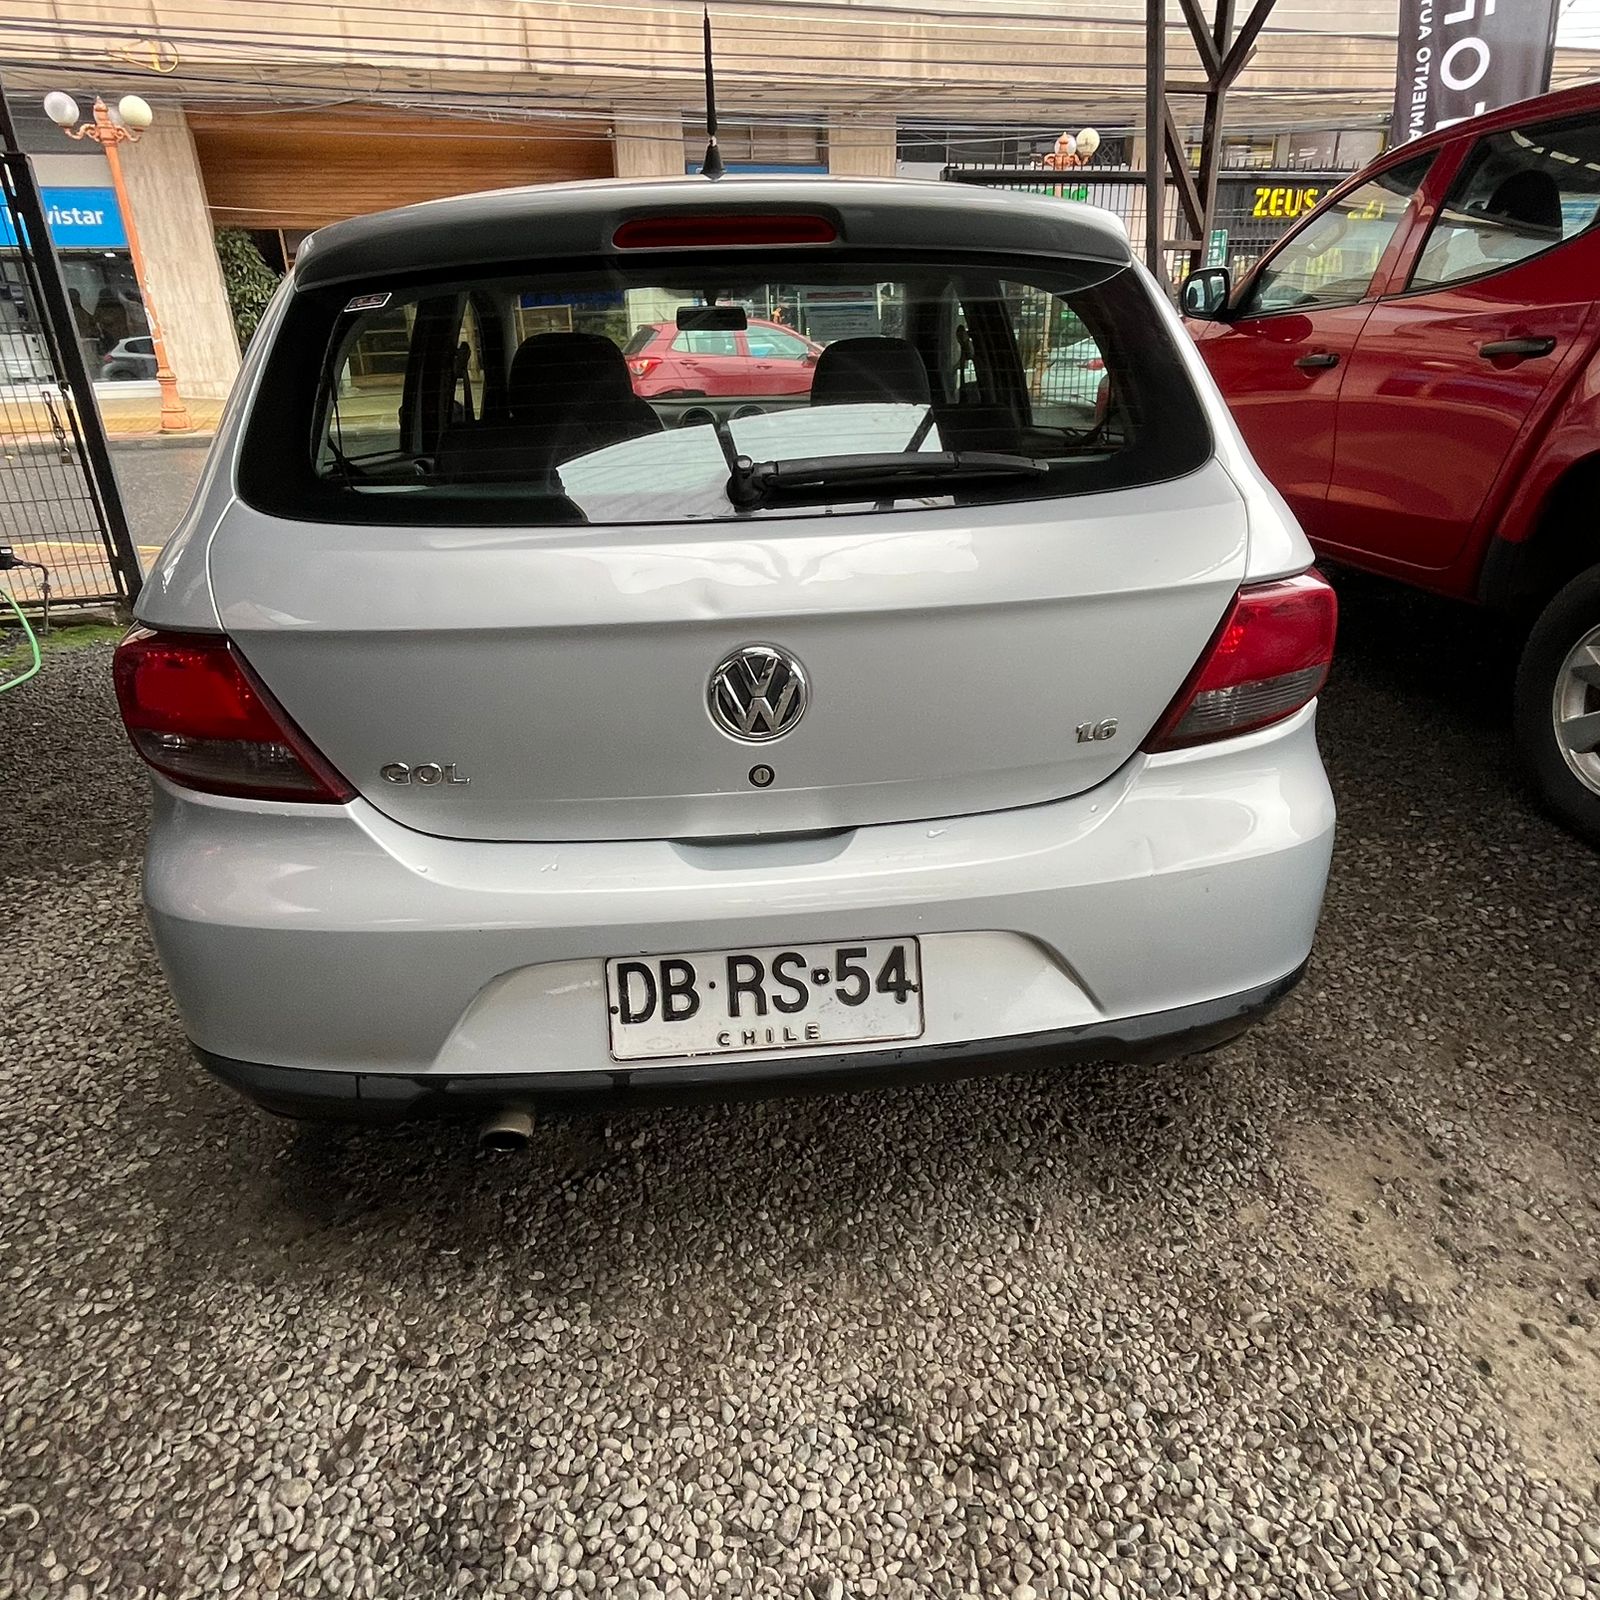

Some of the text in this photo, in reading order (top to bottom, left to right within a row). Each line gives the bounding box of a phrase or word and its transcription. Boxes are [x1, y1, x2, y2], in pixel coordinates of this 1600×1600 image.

[1253, 187, 1319, 217] ZEUS
[380, 762, 471, 786] GOL
[716, 1022, 820, 1047] CHILE
